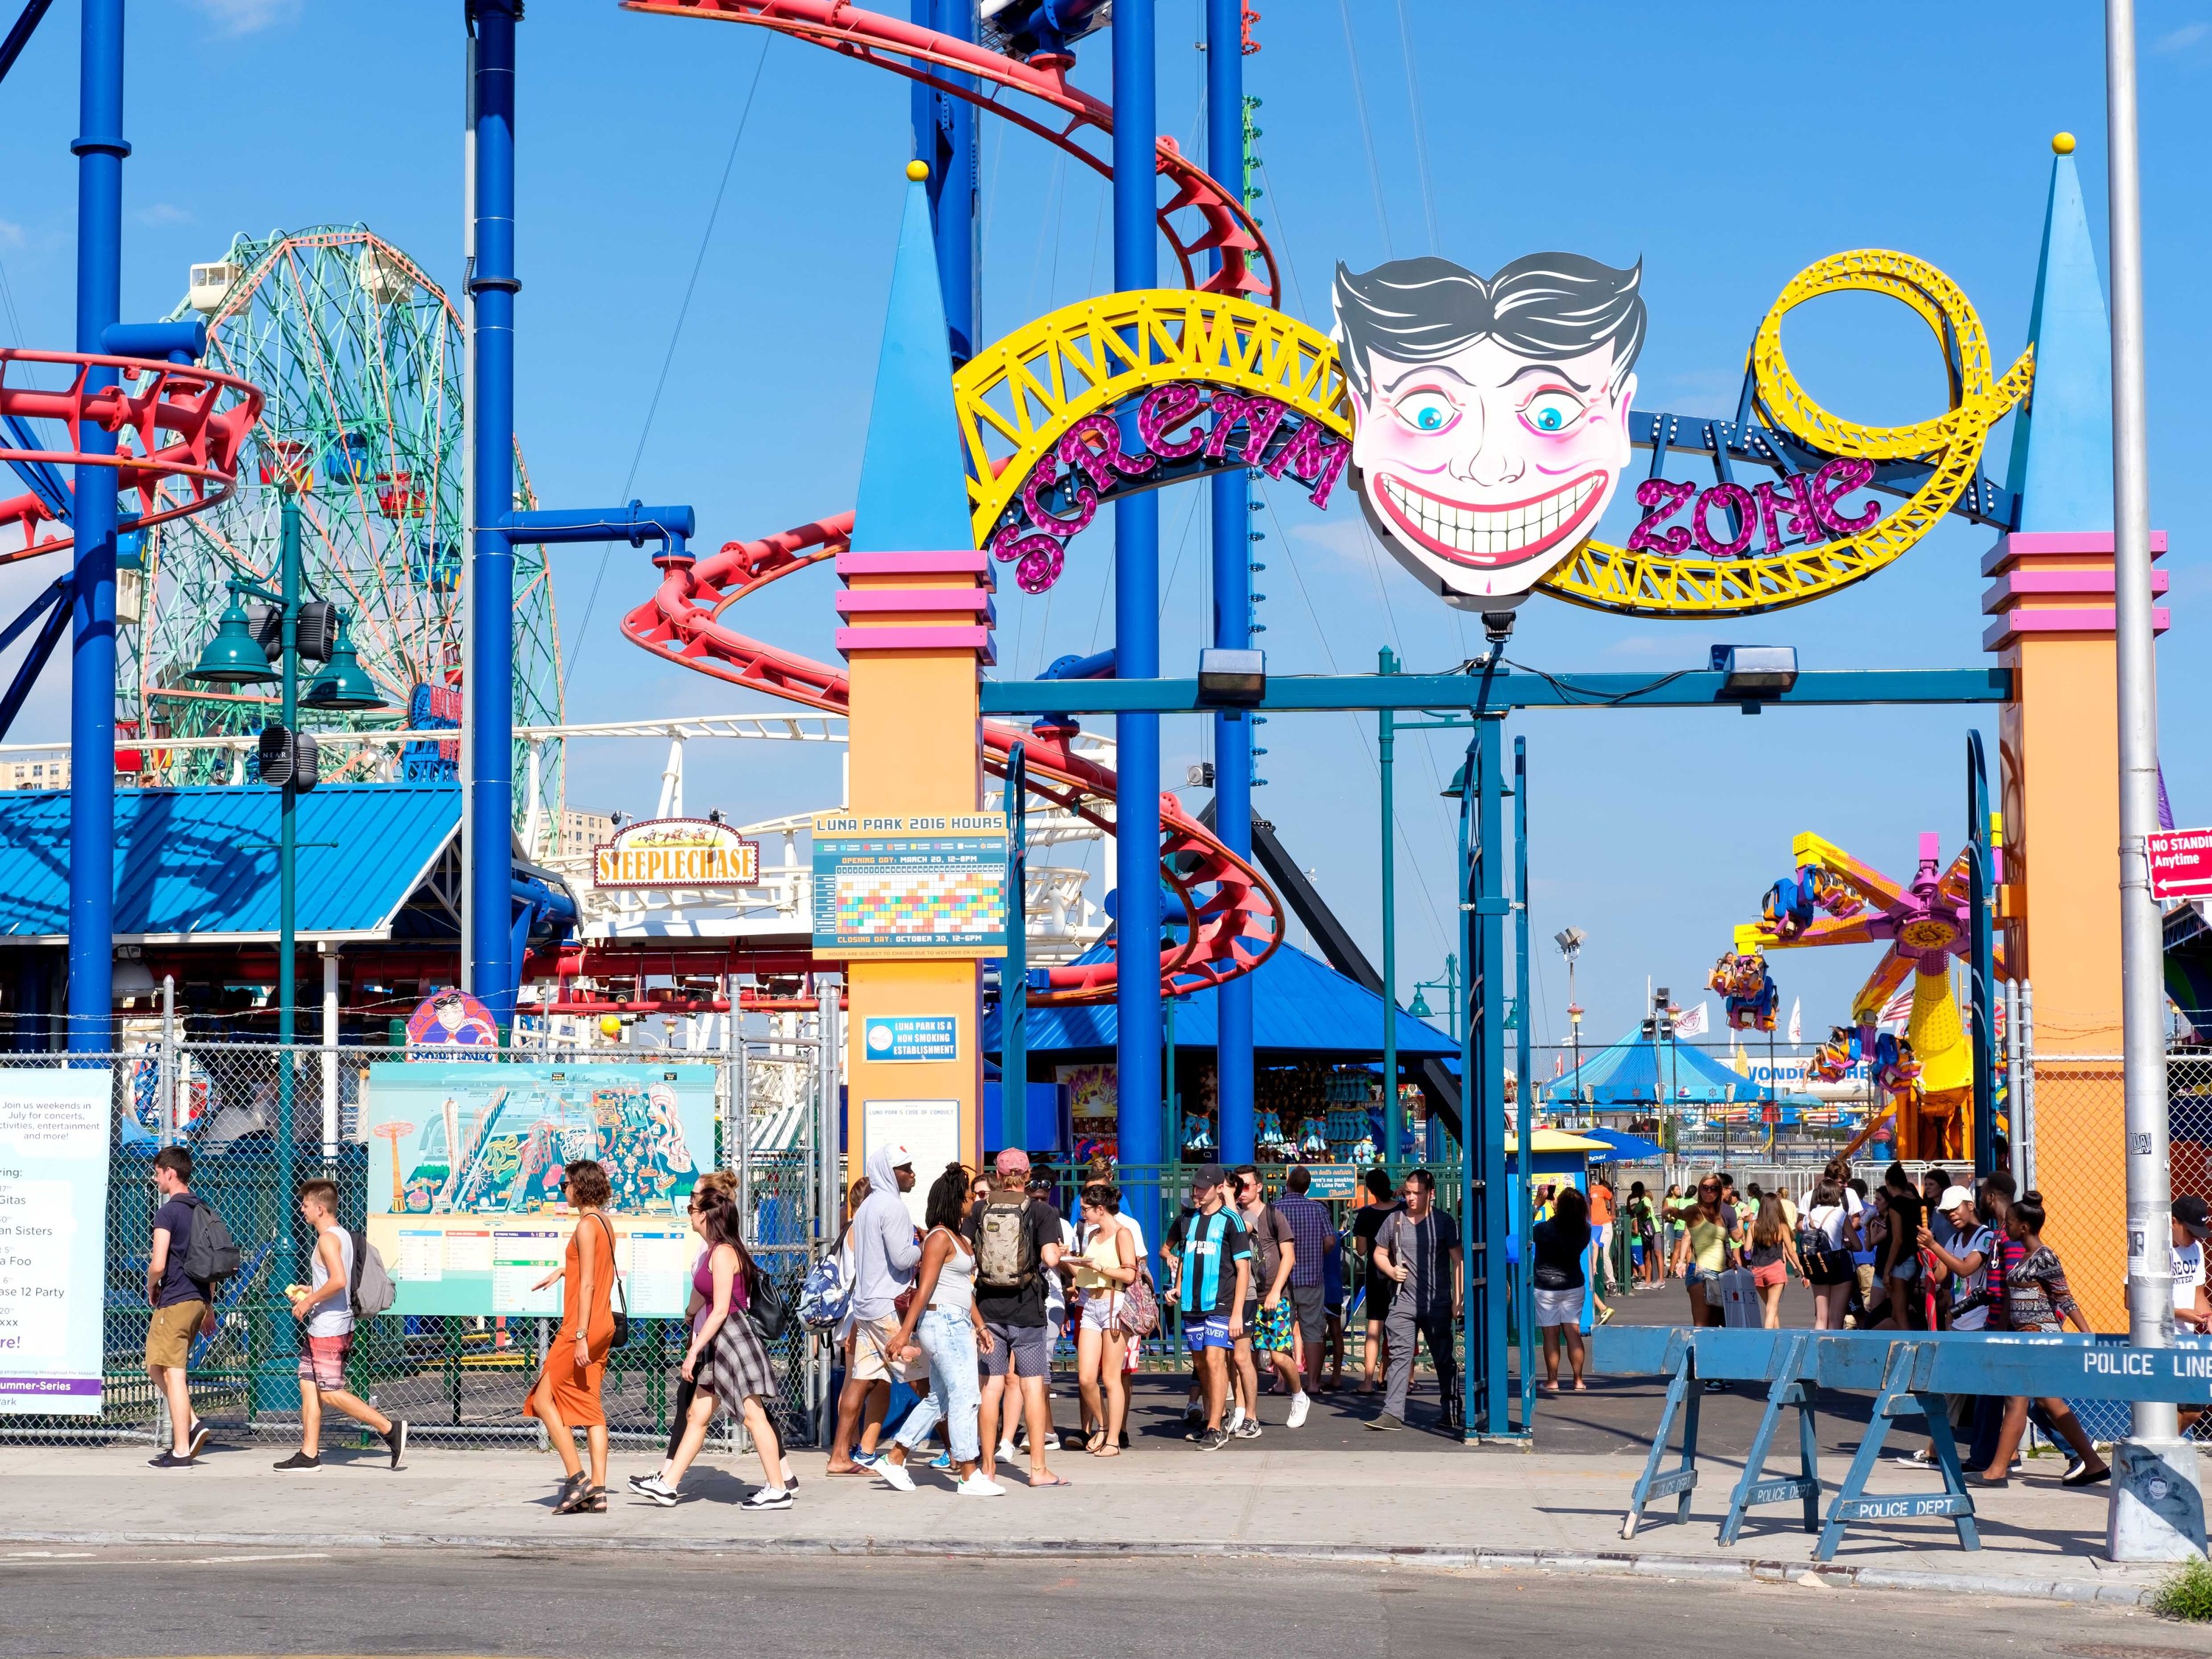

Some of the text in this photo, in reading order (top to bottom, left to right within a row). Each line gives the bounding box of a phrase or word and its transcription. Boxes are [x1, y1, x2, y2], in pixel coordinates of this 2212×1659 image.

[817, 817, 1002, 831] LUNA PARK 2016 HOURS
[2152, 839, 2168, 852] NO
[599, 848, 754, 881] STEEPLECHASE
[2154, 853, 2200, 869] Anytime
[895, 1021, 953, 1031] LUNA PARK IS A
[897, 1033, 950, 1043] NON SMOKING
[894, 1045, 954, 1054] ESTABLISHMENT
[36, 1102, 80, 1110] weekends
[8, 1111, 85, 1121] July for concerts,
[15, 1226, 52, 1236] Sisters
[10, 1256, 32, 1266] Foo
[21, 1287, 32, 1296] 12
[35, 1287, 65, 1298] Party
[2084, 1352, 2154, 1376] POLICE
[1655, 1481, 1675, 1498] POLICE
[1757, 1486, 1786, 1503] POLICE
[1860, 1499, 1955, 1517] POLICE DEPT.
